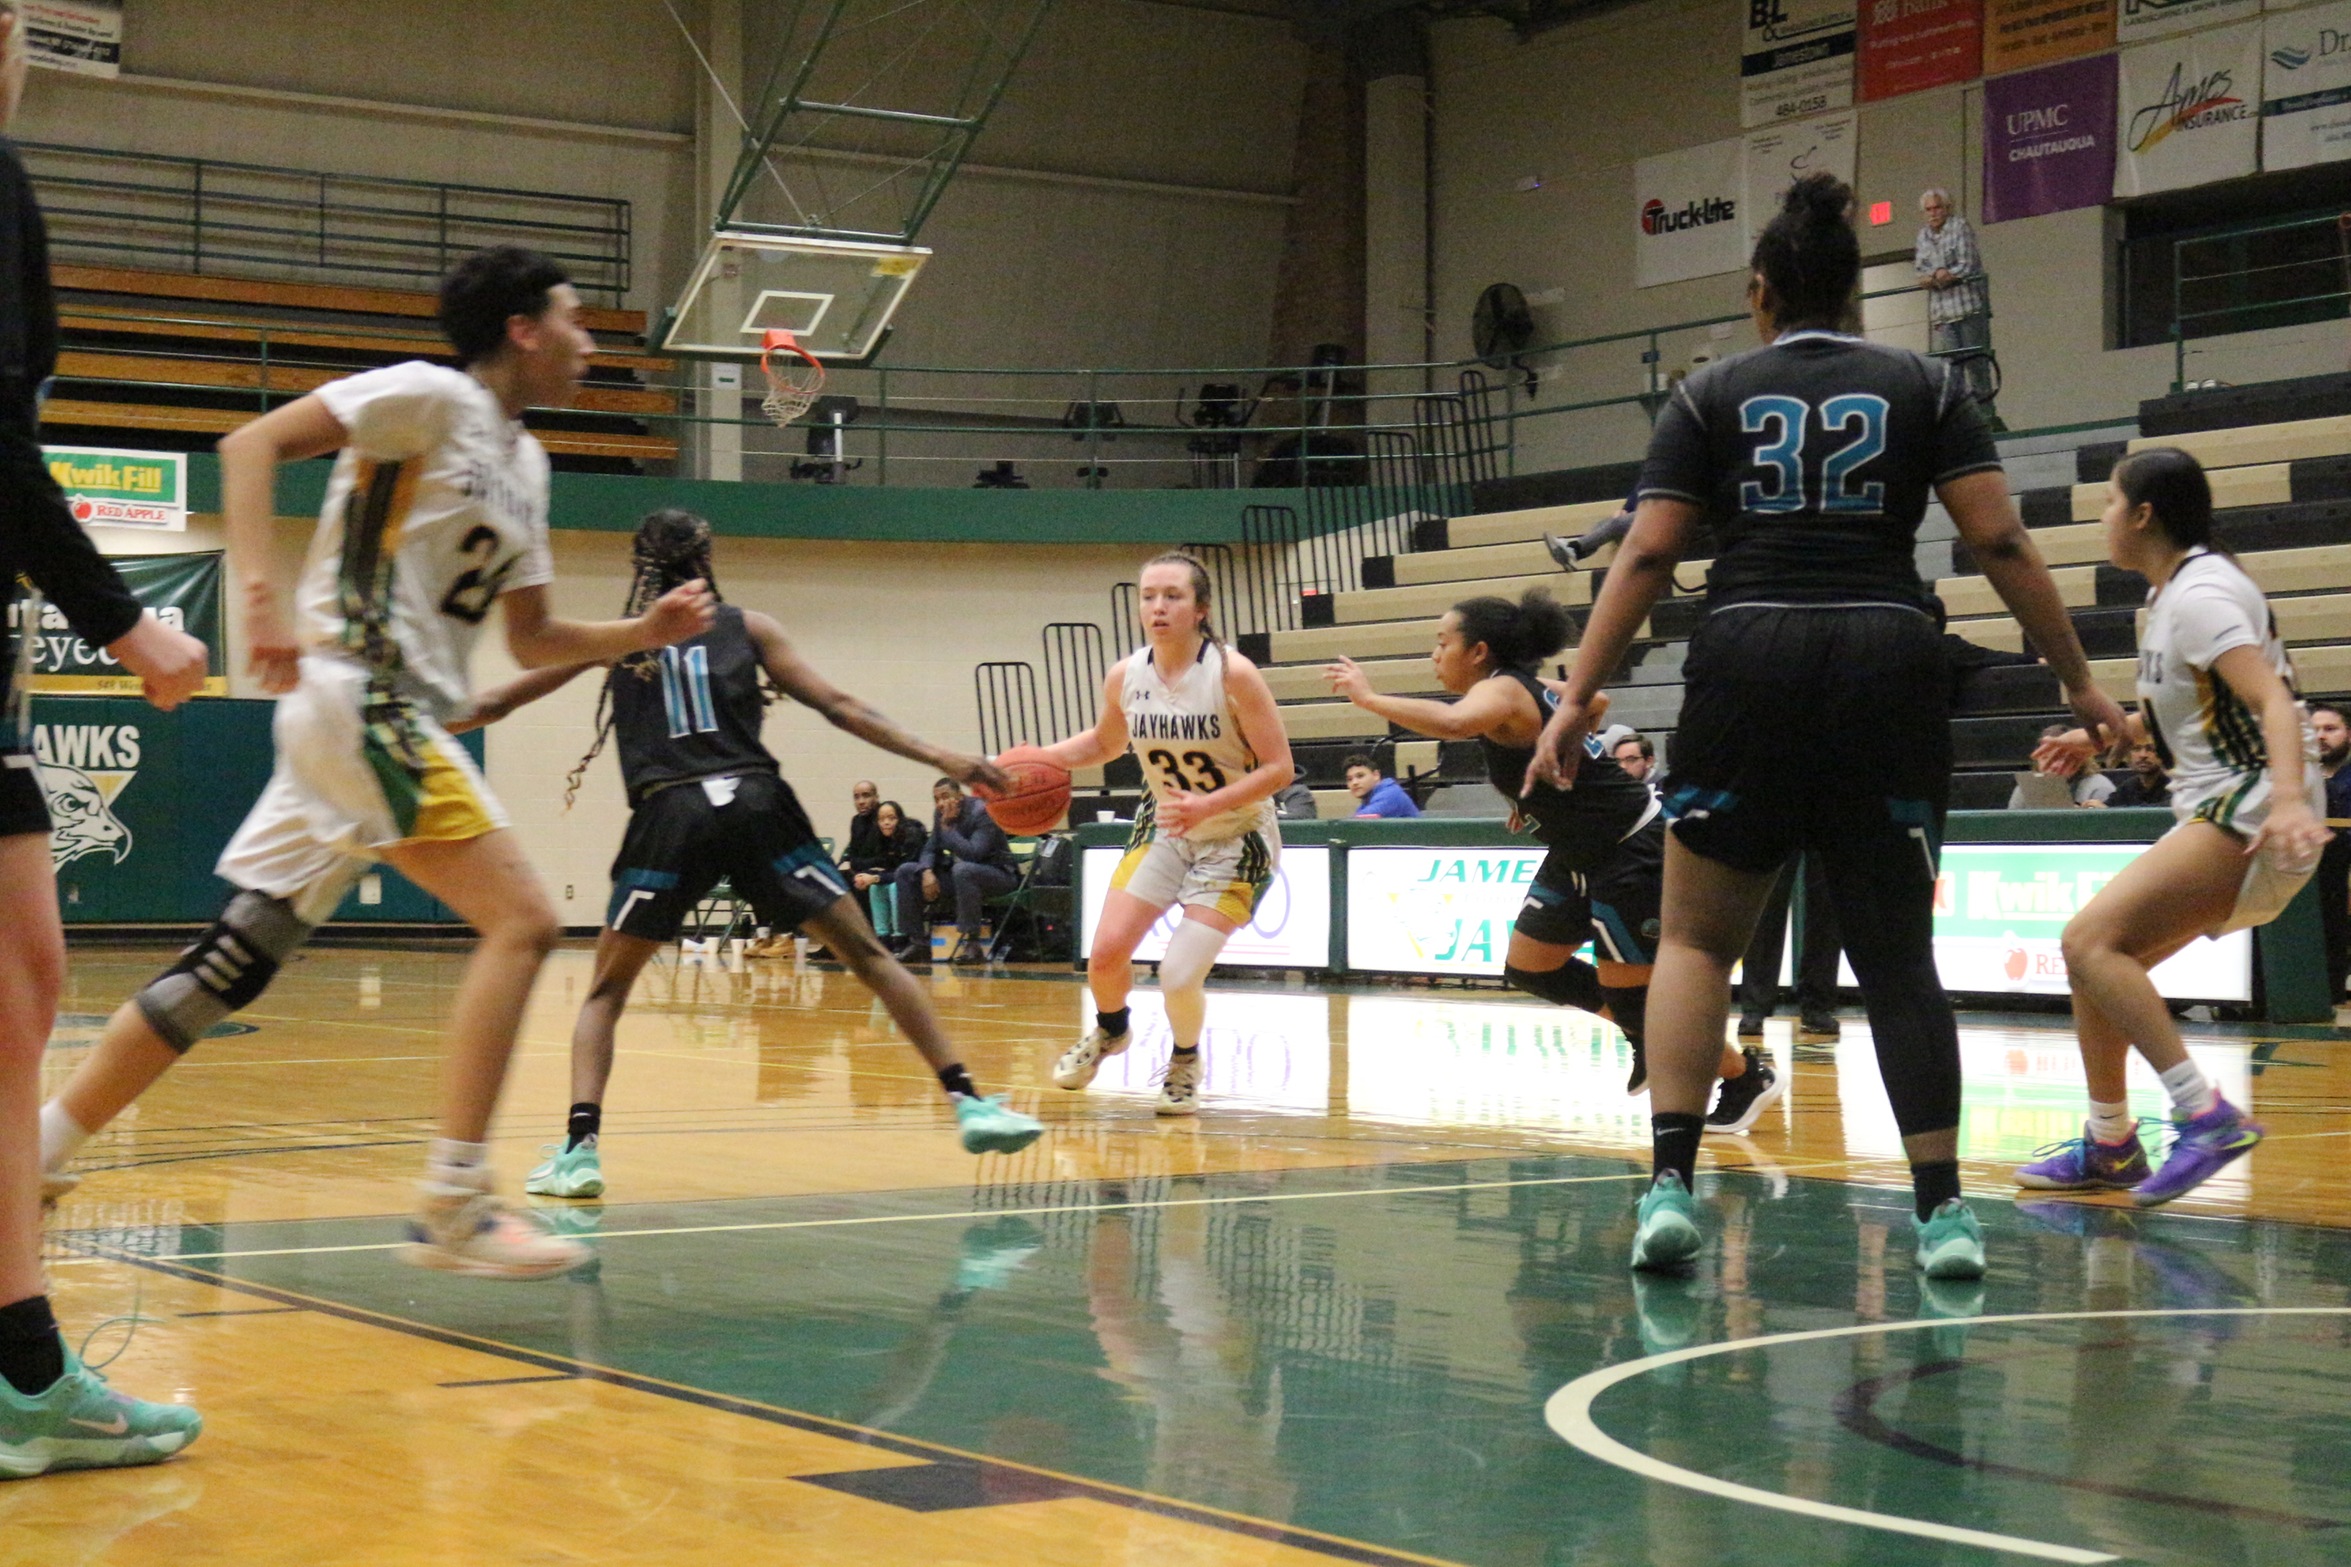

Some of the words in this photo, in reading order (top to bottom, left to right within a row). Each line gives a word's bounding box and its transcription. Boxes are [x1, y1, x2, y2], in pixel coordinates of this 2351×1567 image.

[2006, 104, 2069, 136] UPMC
[2008, 135, 2095, 162] CHAUTAUQUA
[1739, 393, 1890, 514] 32
[658, 645, 719, 738] 11
[1132, 712, 1221, 741] JAYHAWKS
[1148, 749, 1226, 793] 33
[1417, 859, 1538, 884] JAME
